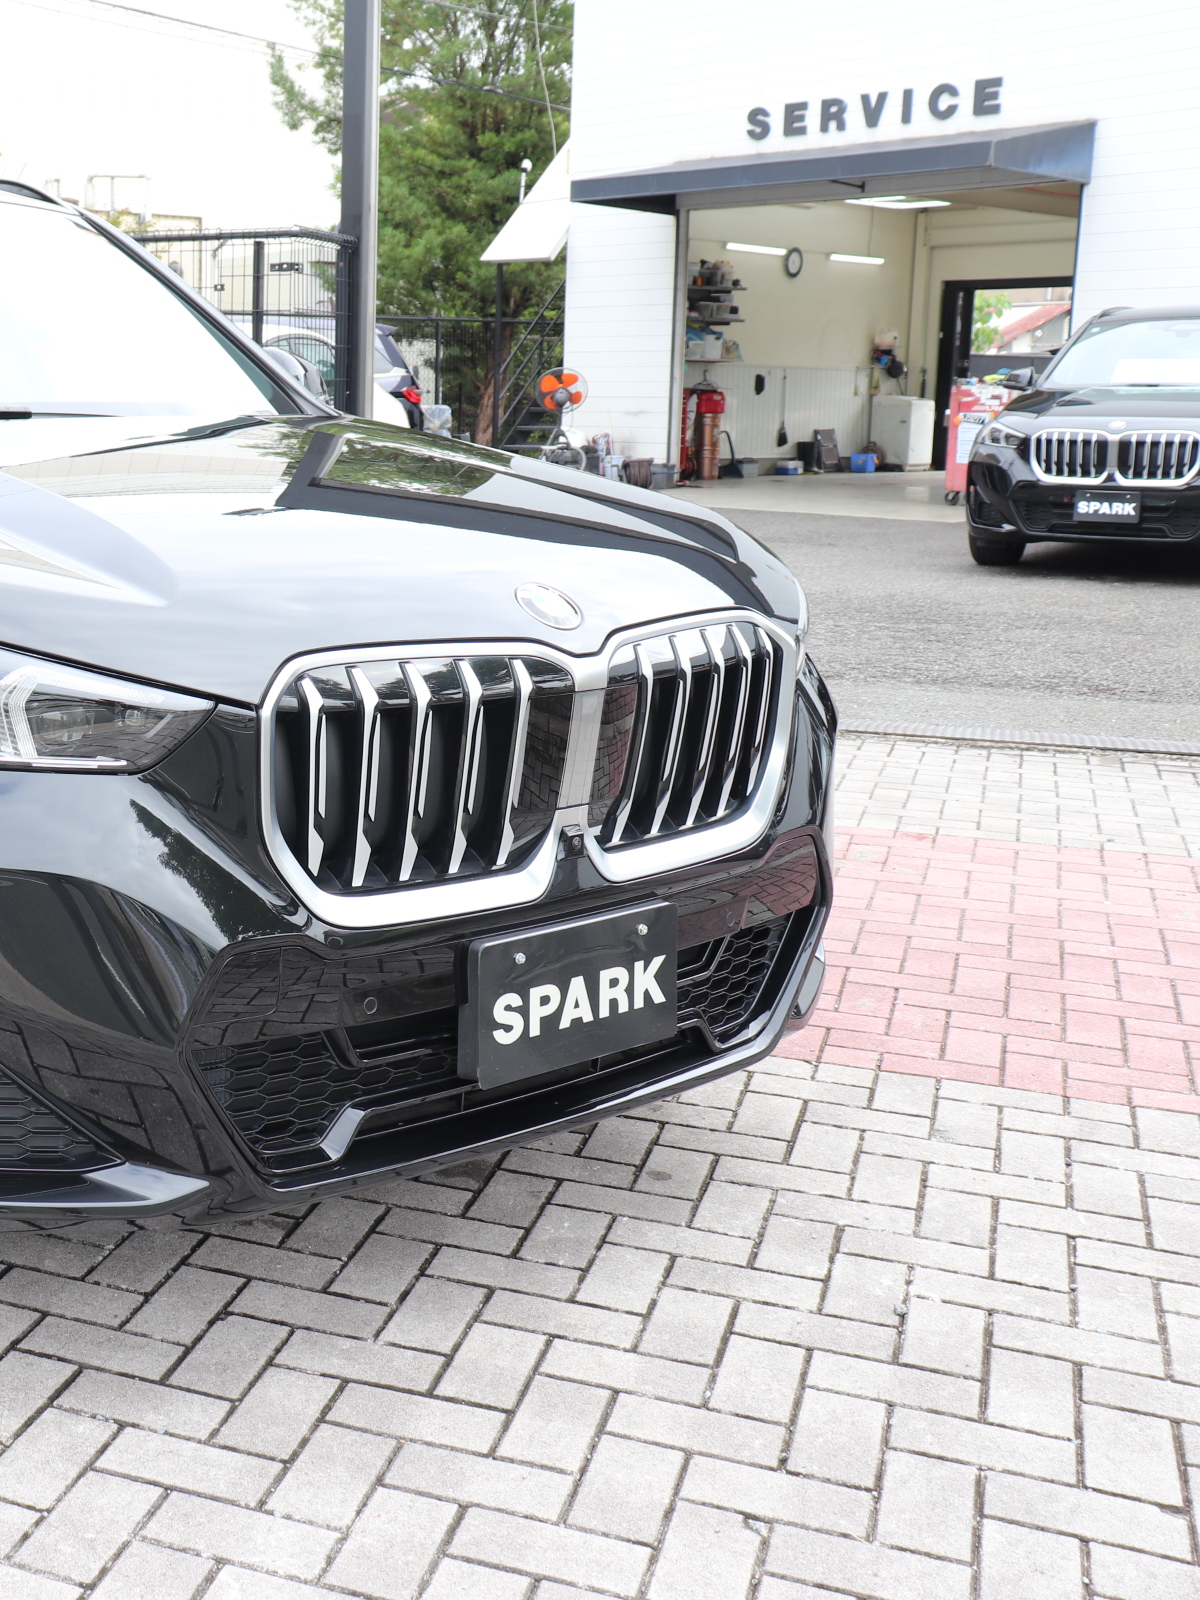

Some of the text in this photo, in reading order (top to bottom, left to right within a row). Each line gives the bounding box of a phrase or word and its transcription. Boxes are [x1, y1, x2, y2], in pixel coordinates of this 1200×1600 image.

[747, 76, 1003, 140] SERVICE
[1077, 501, 1137, 515] SPARK
[492, 954, 667, 1045] SPARK
